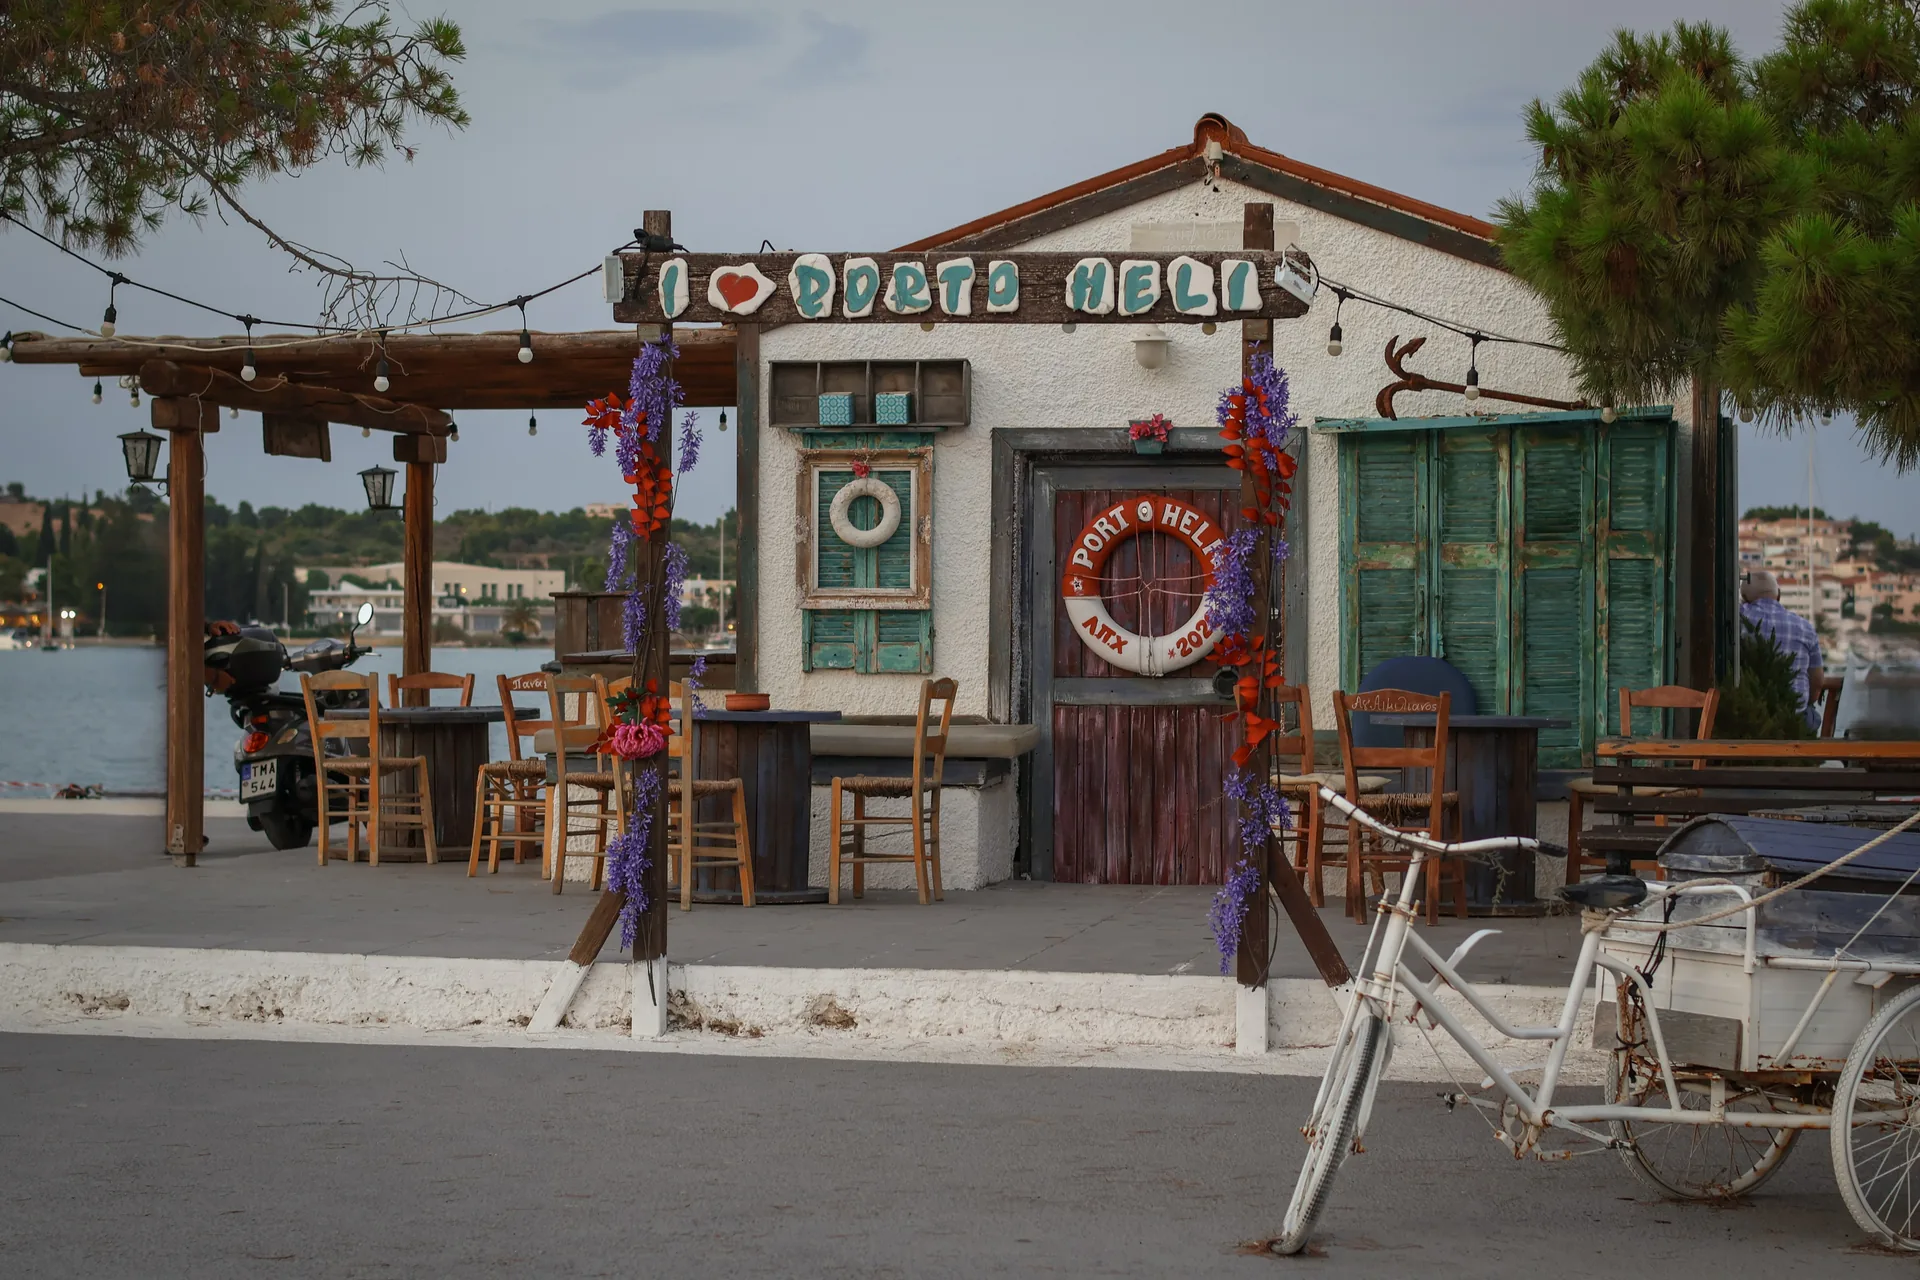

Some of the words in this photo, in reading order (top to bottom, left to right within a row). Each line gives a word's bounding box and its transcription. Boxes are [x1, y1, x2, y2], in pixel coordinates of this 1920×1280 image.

[661, 264, 679, 316] I
[795, 262, 1018, 317] PORTO
[1071, 262, 1249, 313] HELI
[252, 762, 276, 778] TMA
[250, 778, 275, 794] 544
